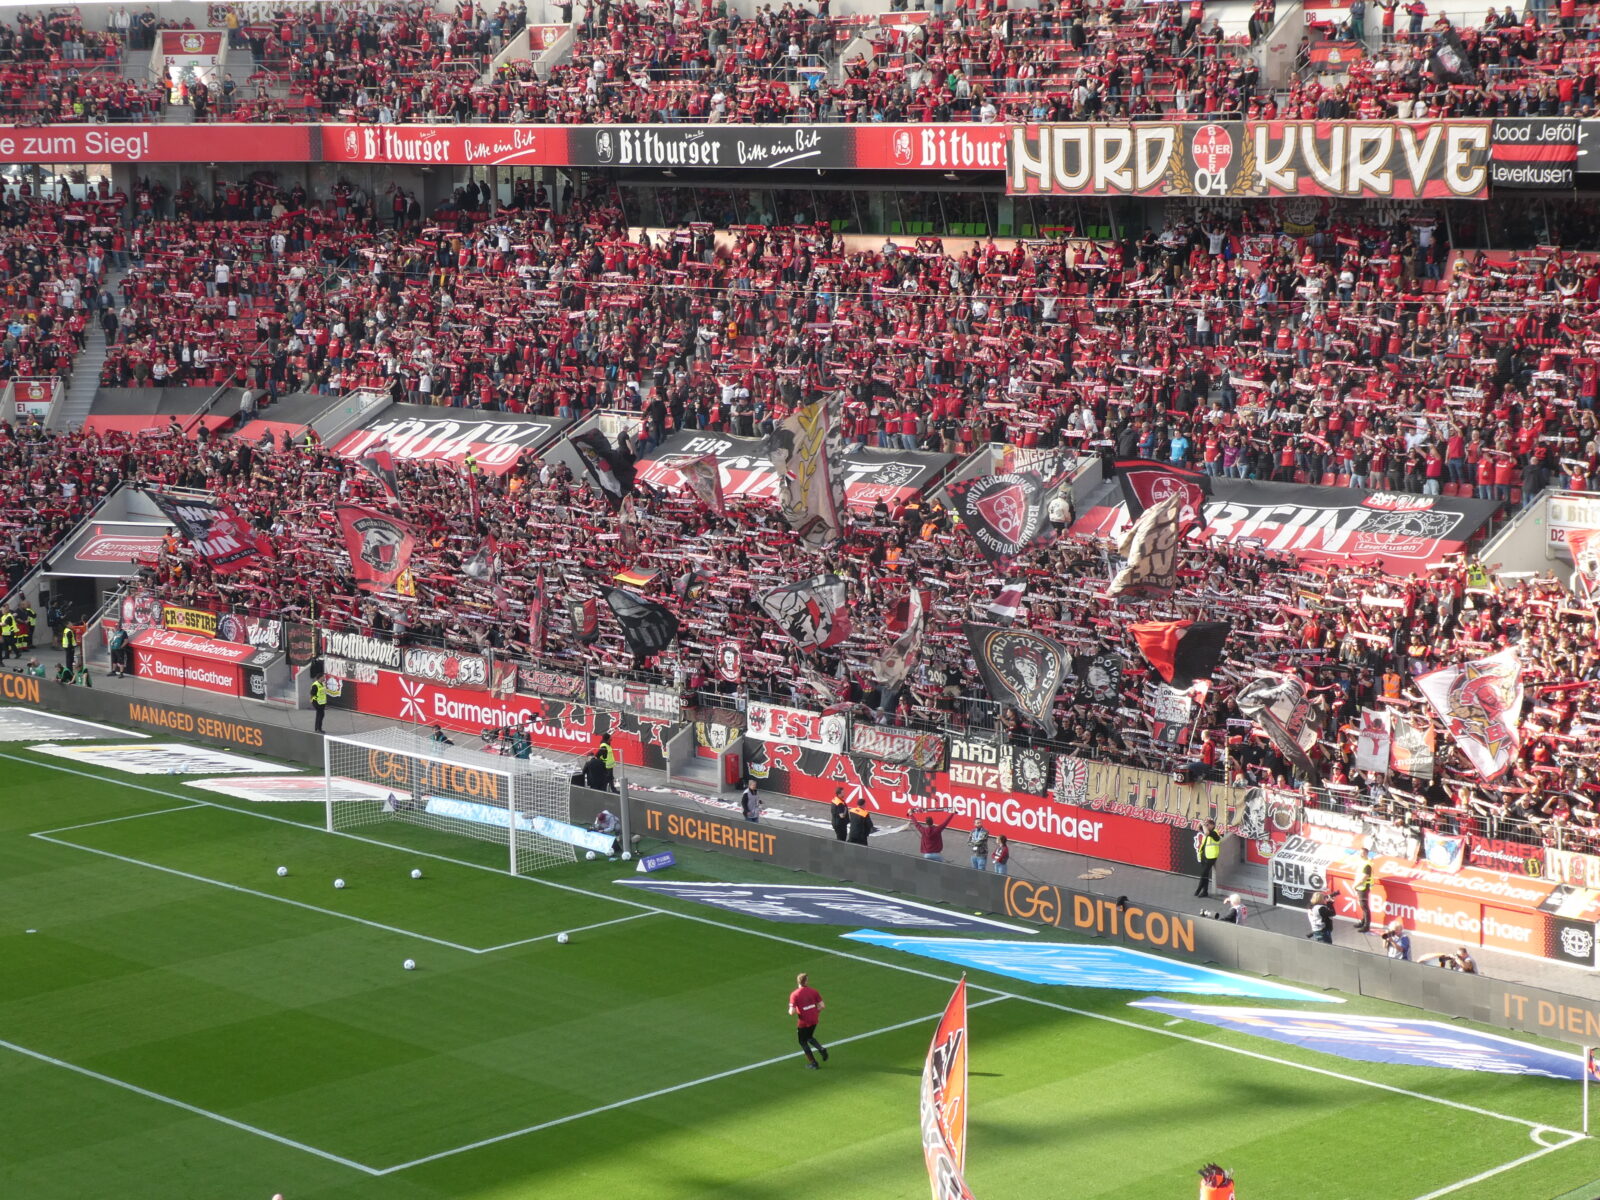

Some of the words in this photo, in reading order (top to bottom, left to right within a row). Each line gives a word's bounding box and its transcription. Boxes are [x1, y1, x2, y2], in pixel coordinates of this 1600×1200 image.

[164, 56, 176, 65] E4
[23, 137, 77, 155] zum
[85, 131, 149, 159] Sieg!
[364, 128, 450, 162] Bitburger
[464, 139, 491, 161] Bitte
[493, 139, 513, 154] ein
[513, 129, 536, 149] Bit
[1492, 123, 1532, 142] Jood
[1536, 123, 1577, 142] Jeföl
[619, 129, 721, 165] Bitburger
[737, 141, 768, 164] Bitte
[771, 139, 794, 155] ein
[796, 130, 821, 151] Bit
[1194, 144, 1231, 155] BAYER
[1254, 123, 1490, 196] KURVE
[1194, 168, 1228, 195] 04
[1492, 162, 1573, 184] Leverkusen
[17, 403, 26, 413] E1
[346, 421, 543, 463] 1904%
[681, 437, 733, 454] FÜR
[1357, 541, 1417, 552] Leverkusen
[1551, 528, 1565, 542] D2
[91, 550, 141, 559] SOFTWAR
[162, 635, 242, 658] BarmeniaGothaer
[155, 661, 233, 687] BarmeniaGothaer
[0, 673, 40, 704] CON
[129, 703, 194, 732] MANAGED
[197, 717, 263, 747] SERVICES
[769, 707, 823, 742] FSI
[952, 738, 997, 764] MAD
[950, 763, 1000, 789] BOYZ
[646, 809, 663, 831] IT
[667, 813, 777, 856] SICHERHEIT
[1284, 836, 1323, 854] DER
[1471, 844, 1524, 863] Leverkusen
[1274, 860, 1306, 886] DEN
[1379, 860, 1546, 903] BarmeniaGothaer
[1073, 894, 1195, 952] DITCON
[1369, 894, 1533, 943] BarmeniaGothaer
[1504, 992, 1528, 1021] IT
